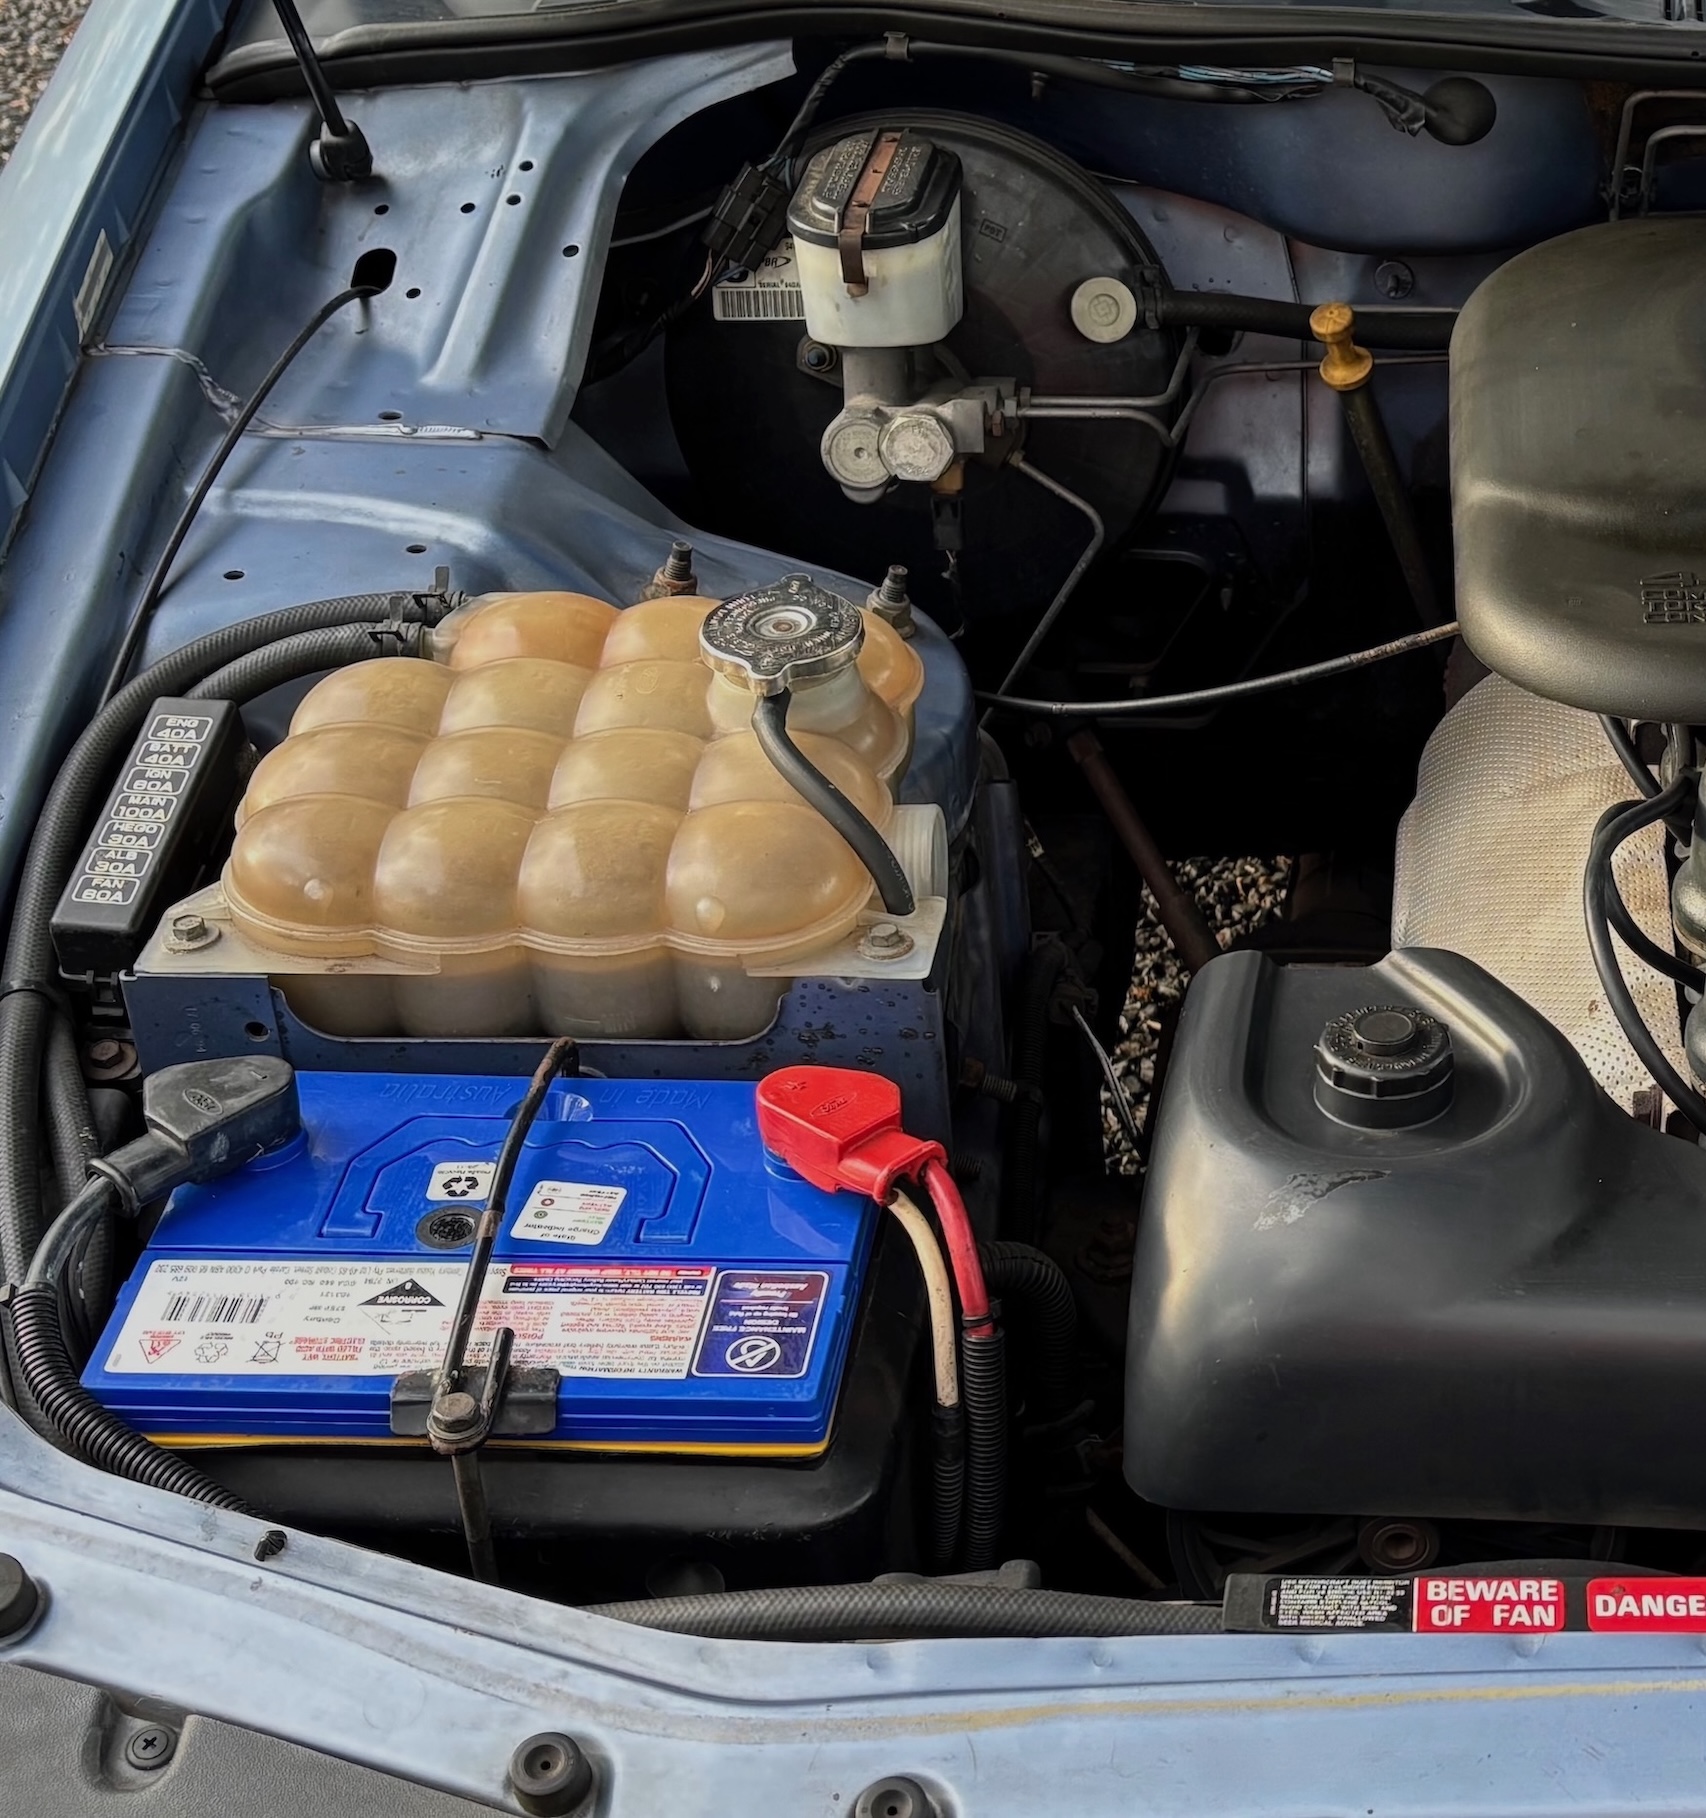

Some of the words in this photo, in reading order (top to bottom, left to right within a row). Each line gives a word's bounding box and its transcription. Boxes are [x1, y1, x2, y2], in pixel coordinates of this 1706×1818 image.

[166, 717, 199, 728] ENG
[156, 728, 197, 740] 40A
[149, 743, 193, 753] BATT
[144, 754, 185, 765] 40A
[145, 769, 172, 779] IGN
[128, 795, 166, 806] MAIN
[118, 806, 165, 820] 100A
[113, 823, 158, 834] HEGO
[108, 834, 149, 847] 30A
[94, 861, 136, 874] 30A
[91, 878, 125, 889] FAN
[379, 1082, 510, 1107] Australia
[599, 1088, 623, 1108] in
[637, 1089, 712, 1110] Made
[568, 1227, 600, 1235] Charge
[376, 1295, 432, 1305] CORROSIVE
[303, 1316, 340, 1324] Century
[711, 1325, 737, 1333] FREE
[739, 1326, 806, 1334] MAINTENANCE
[1427, 1580, 1558, 1602] BEWARE
[1431, 1603, 1468, 1627] OF
[1493, 1603, 1556, 1627] FAN
